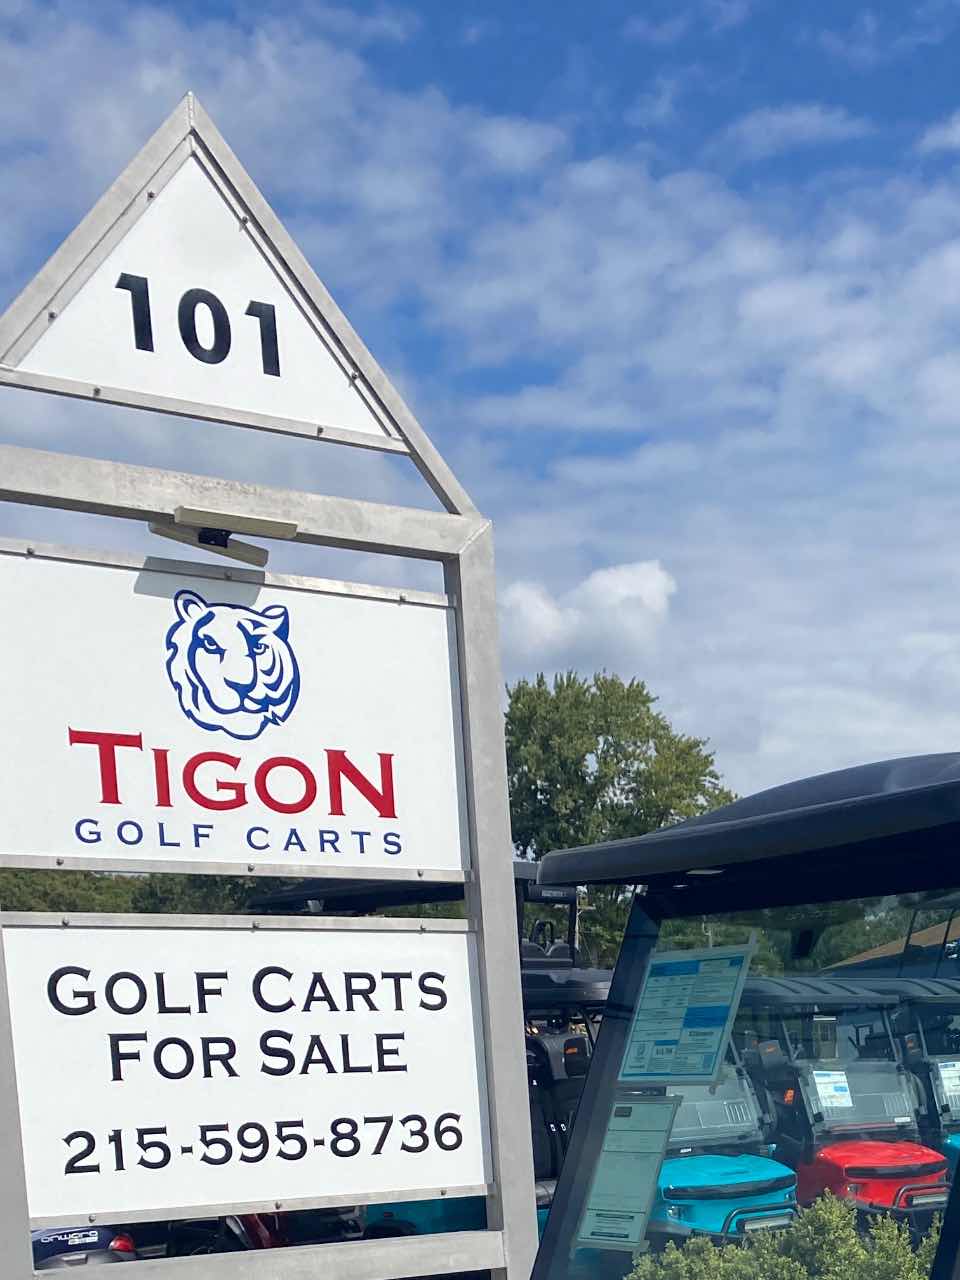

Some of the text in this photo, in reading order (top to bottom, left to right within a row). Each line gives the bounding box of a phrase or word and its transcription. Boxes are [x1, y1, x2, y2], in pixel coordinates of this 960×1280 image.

[115, 271, 281, 377] 101
[68, 726, 398, 818] TIGON
[74, 818, 403, 855] GOLF CARTS
[47, 965, 449, 1016] GOLF CARTS
[107, 1029, 409, 1082] FOR SALE
[62, 1112, 463, 1174] 215-595-8736
